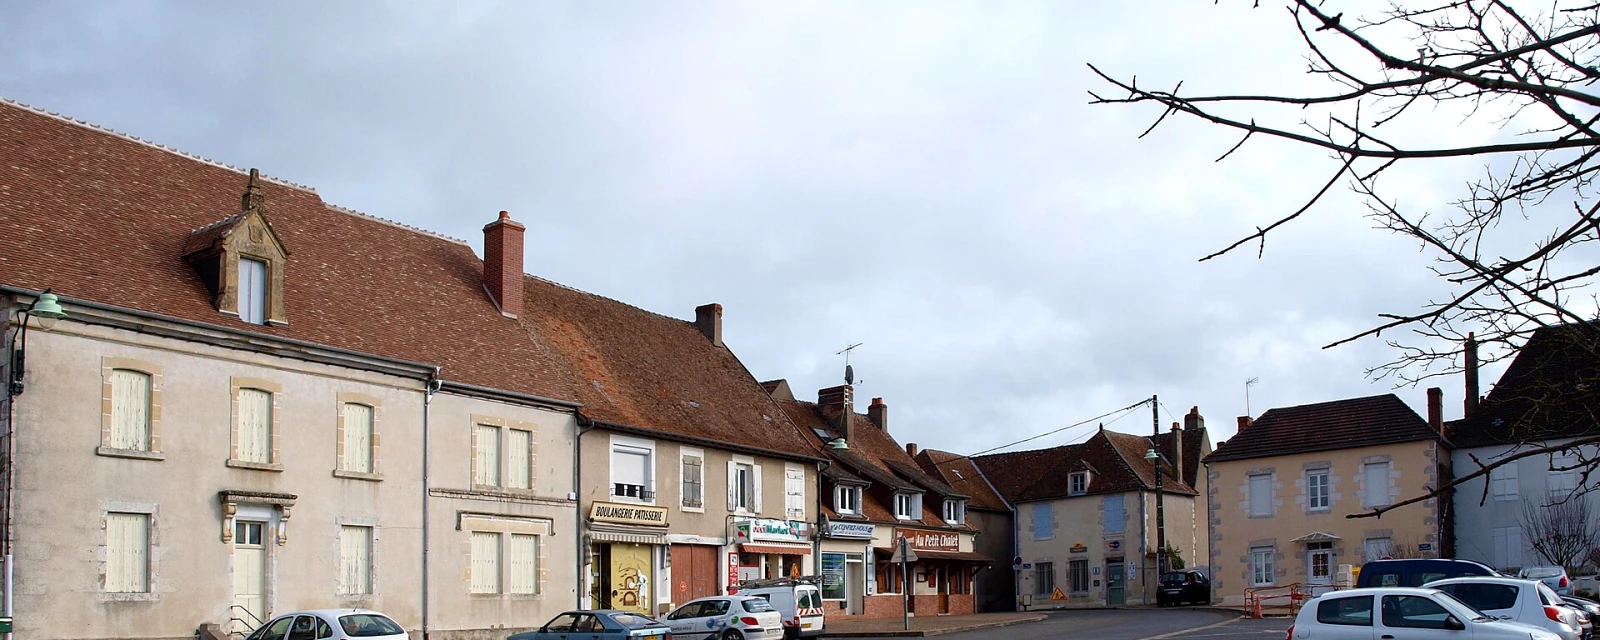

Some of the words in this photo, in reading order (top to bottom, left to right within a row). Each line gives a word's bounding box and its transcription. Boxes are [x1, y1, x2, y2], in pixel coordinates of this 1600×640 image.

[596, 506, 633, 519] BOULANGERIE
[634, 509, 663, 521] PATISSERIE
[916, 535, 924, 546] Au
[925, 535, 939, 546] Petit
[941, 535, 958, 546] Chalet
